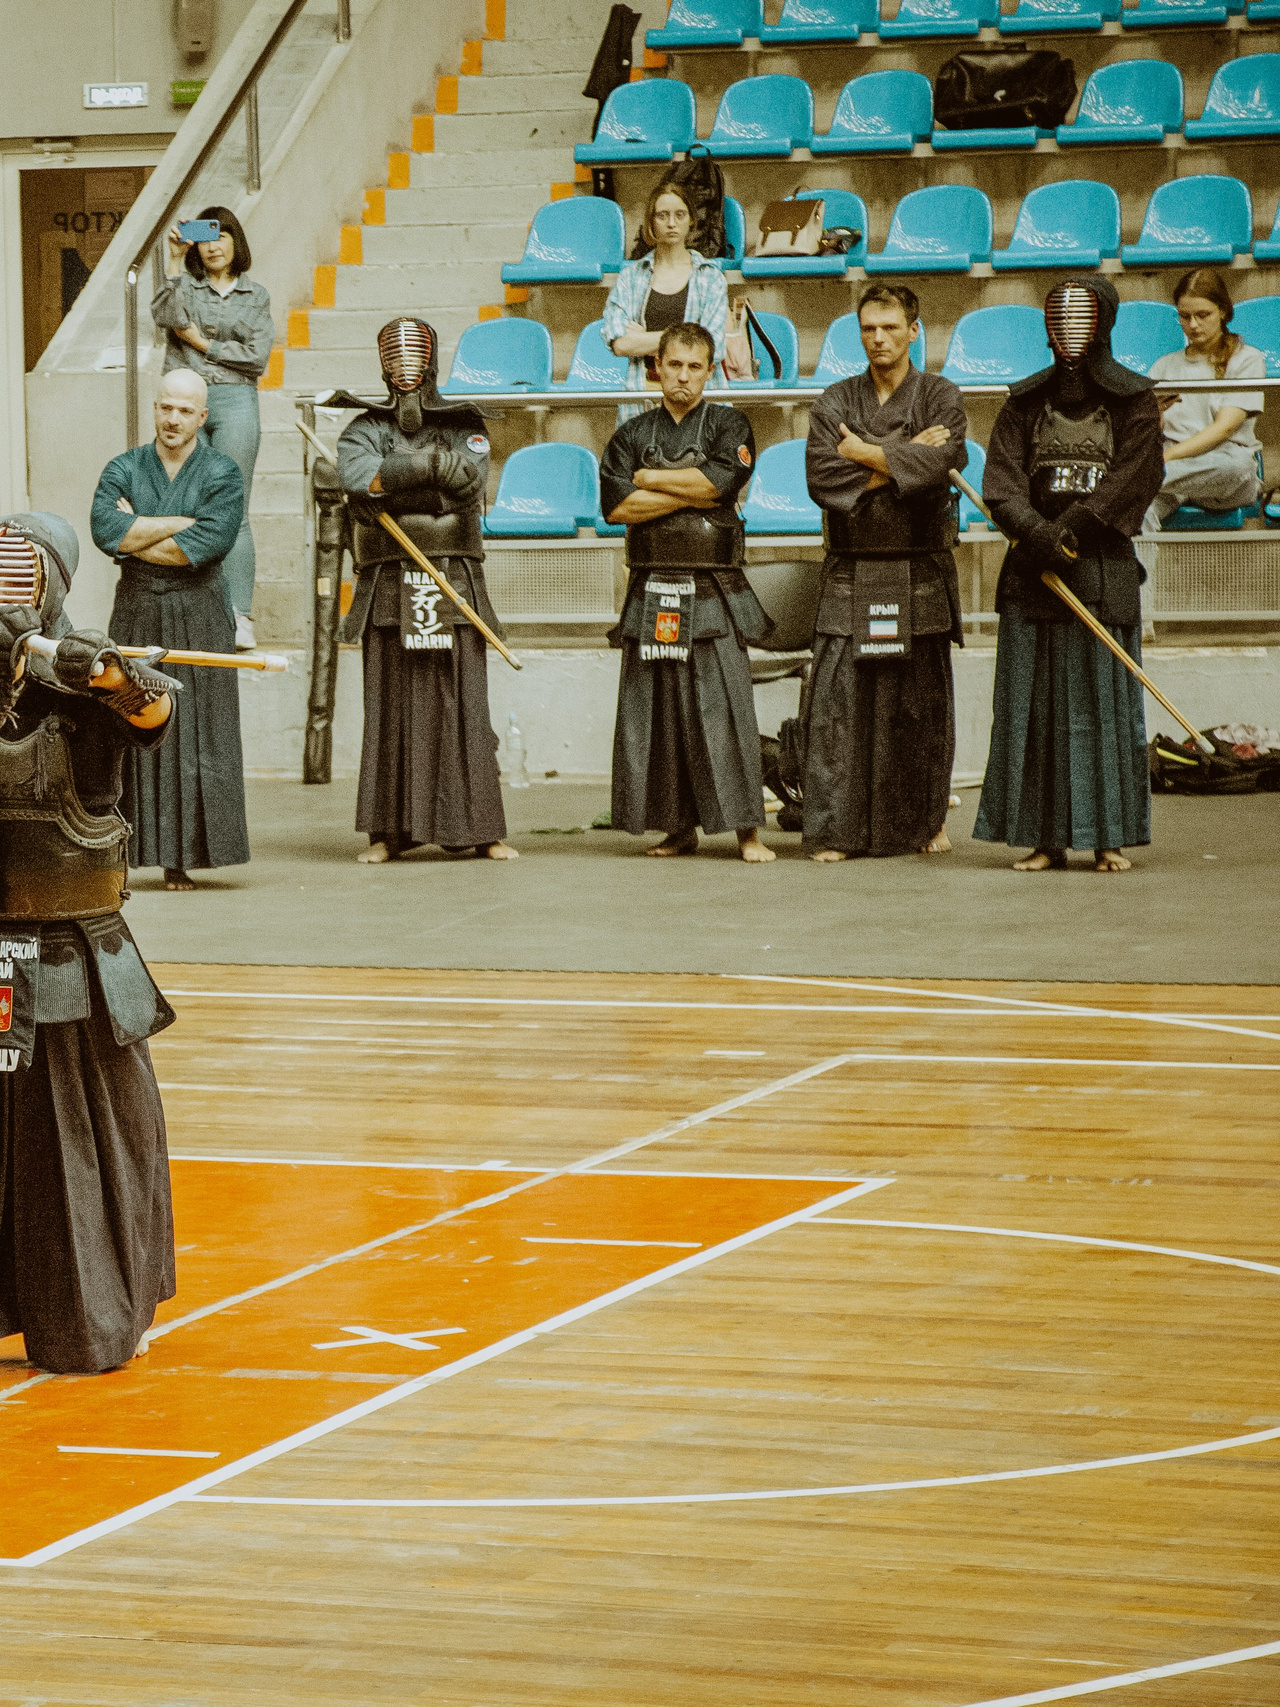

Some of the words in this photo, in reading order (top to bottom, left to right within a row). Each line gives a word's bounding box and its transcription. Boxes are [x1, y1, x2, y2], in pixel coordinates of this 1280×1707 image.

[410, 584, 444, 636] アガリン
[869, 604, 899, 615] КРЫМ
[405, 633, 453, 649] AGARIN
[640, 644, 689, 662] ПАНИН
